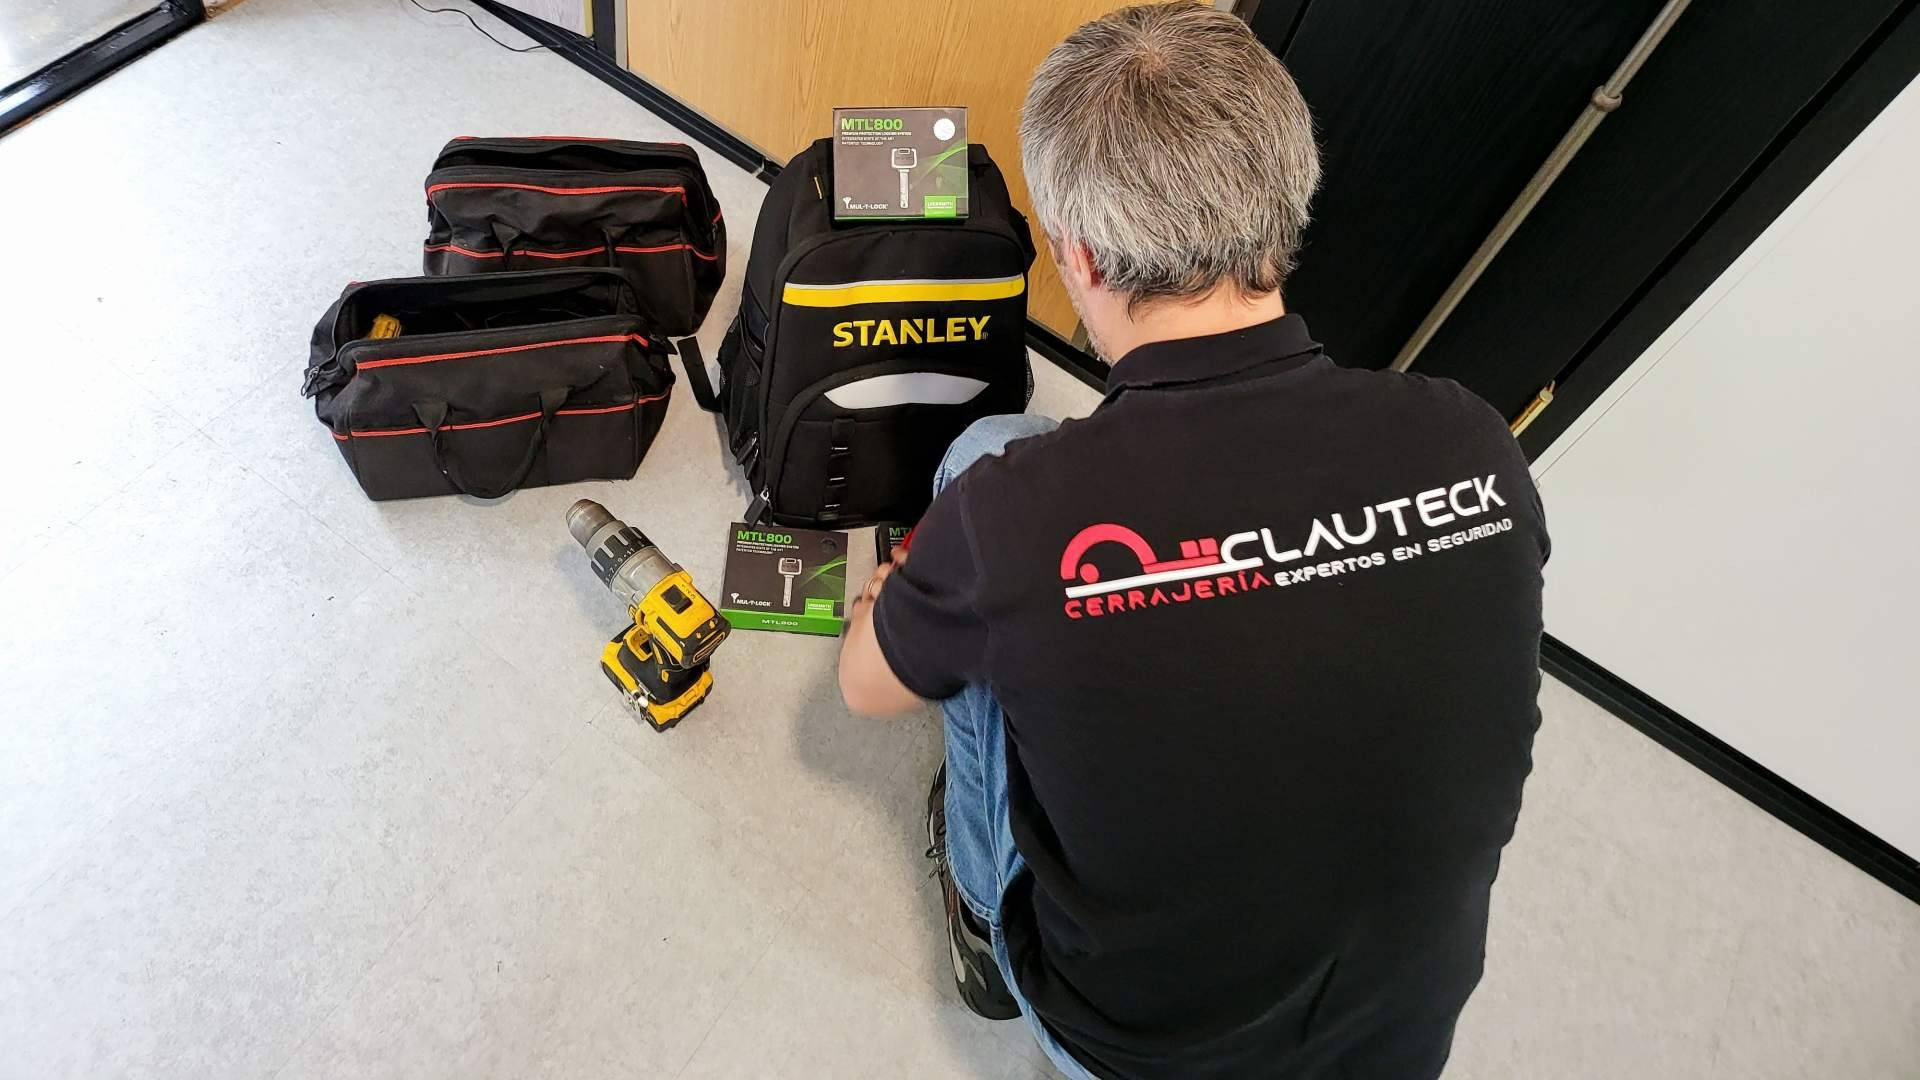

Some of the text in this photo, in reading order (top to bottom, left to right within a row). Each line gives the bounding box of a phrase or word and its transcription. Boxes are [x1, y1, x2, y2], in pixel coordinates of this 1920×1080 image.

[841, 118, 903, 131] MTL800
[833, 315, 991, 347] STANLEY
[1220, 474, 1508, 565] CLAUTECK
[737, 530, 792, 544] MTL800
[1274, 518, 1513, 587] EXPERTOS EN SEGURIDAD
[736, 599, 771, 607] MUL-T-LOCK
[1064, 570, 1271, 619] CERRAJERÍA
